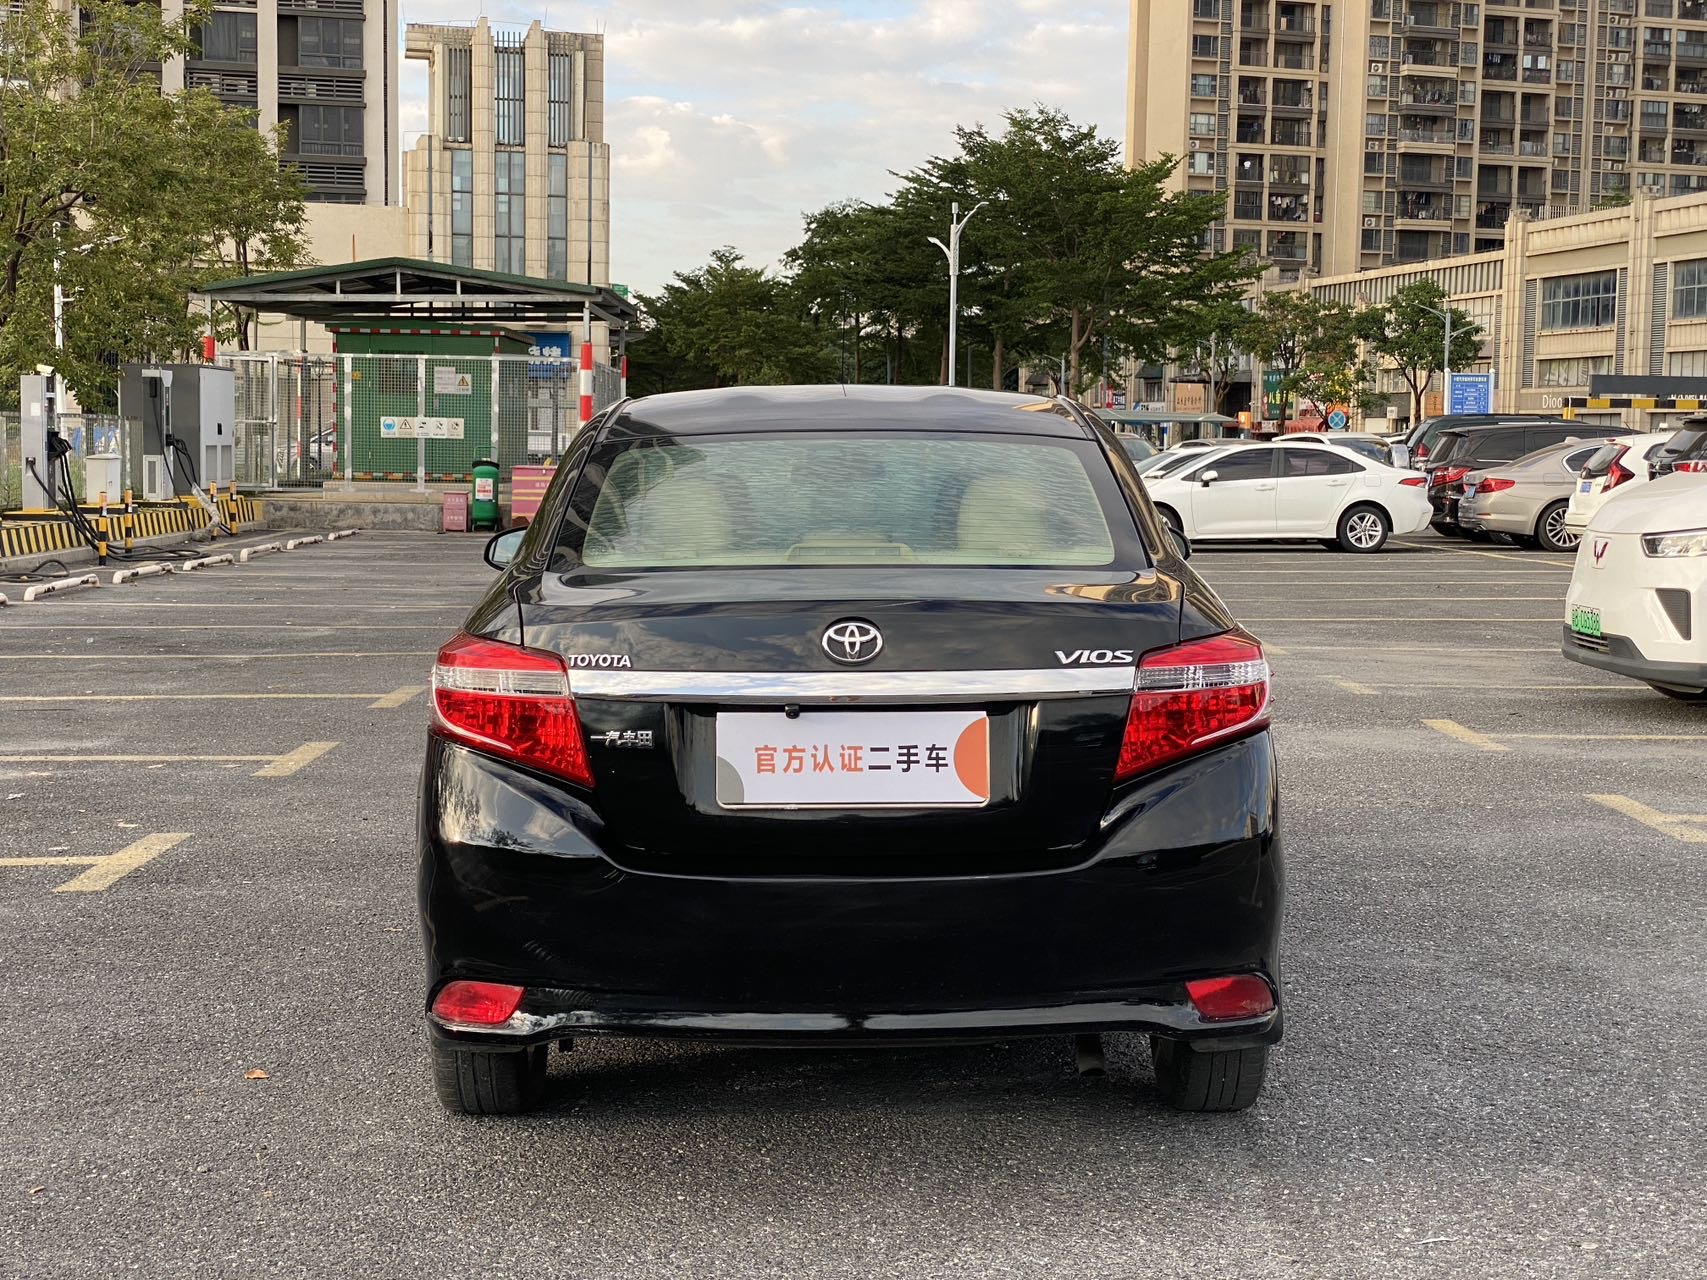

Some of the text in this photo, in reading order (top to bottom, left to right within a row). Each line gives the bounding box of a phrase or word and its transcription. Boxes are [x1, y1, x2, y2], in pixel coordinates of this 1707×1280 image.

[568, 653, 632, 668] TOYOTA
[1054, 649, 1134, 665] VIOS
[754, 744, 949, 774] 官方认证二手车
